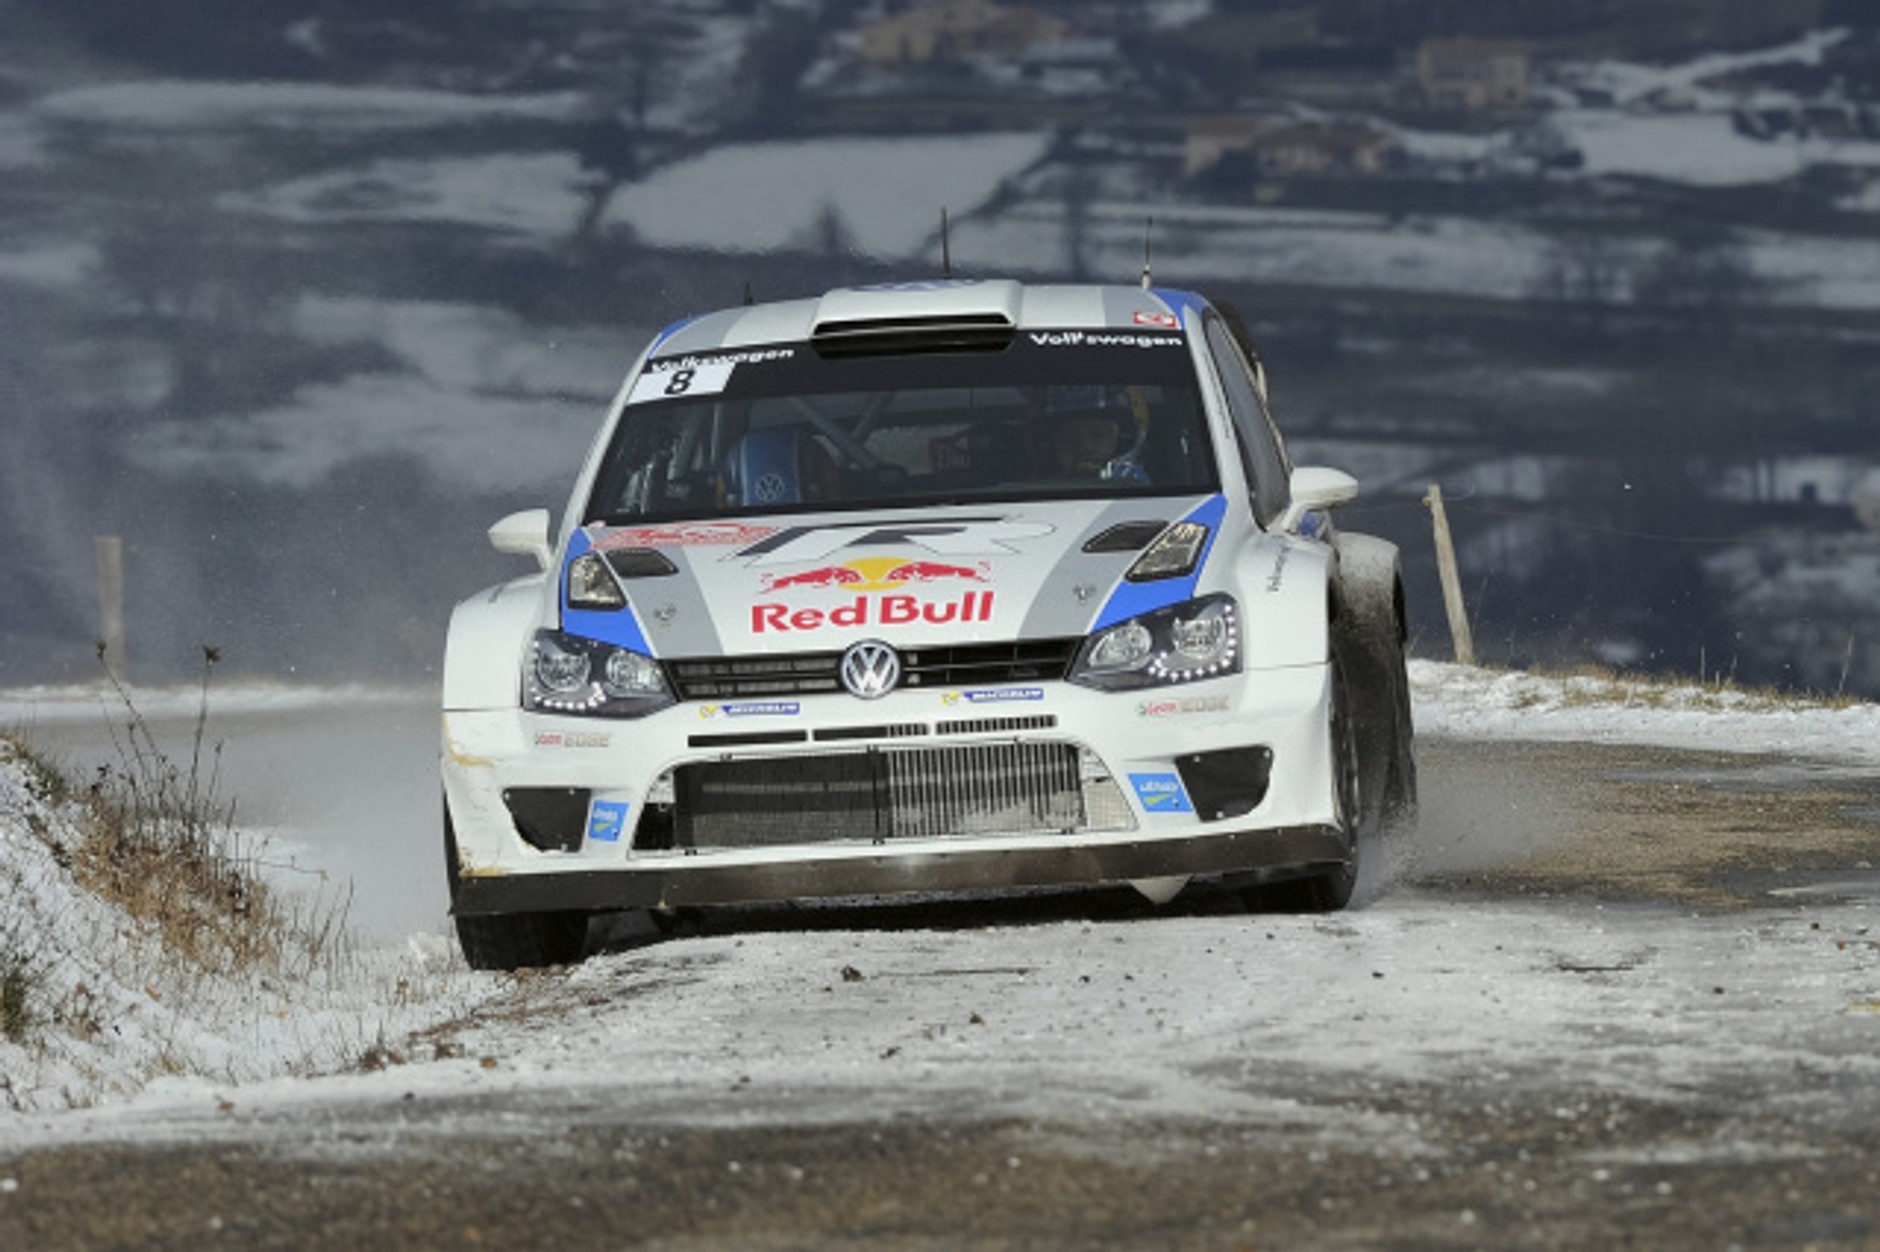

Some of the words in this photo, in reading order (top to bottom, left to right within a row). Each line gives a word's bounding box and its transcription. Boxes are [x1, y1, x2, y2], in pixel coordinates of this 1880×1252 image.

[664, 370, 695, 395] 8
[752, 596, 868, 633] Red
[880, 591, 994, 625] Bull
